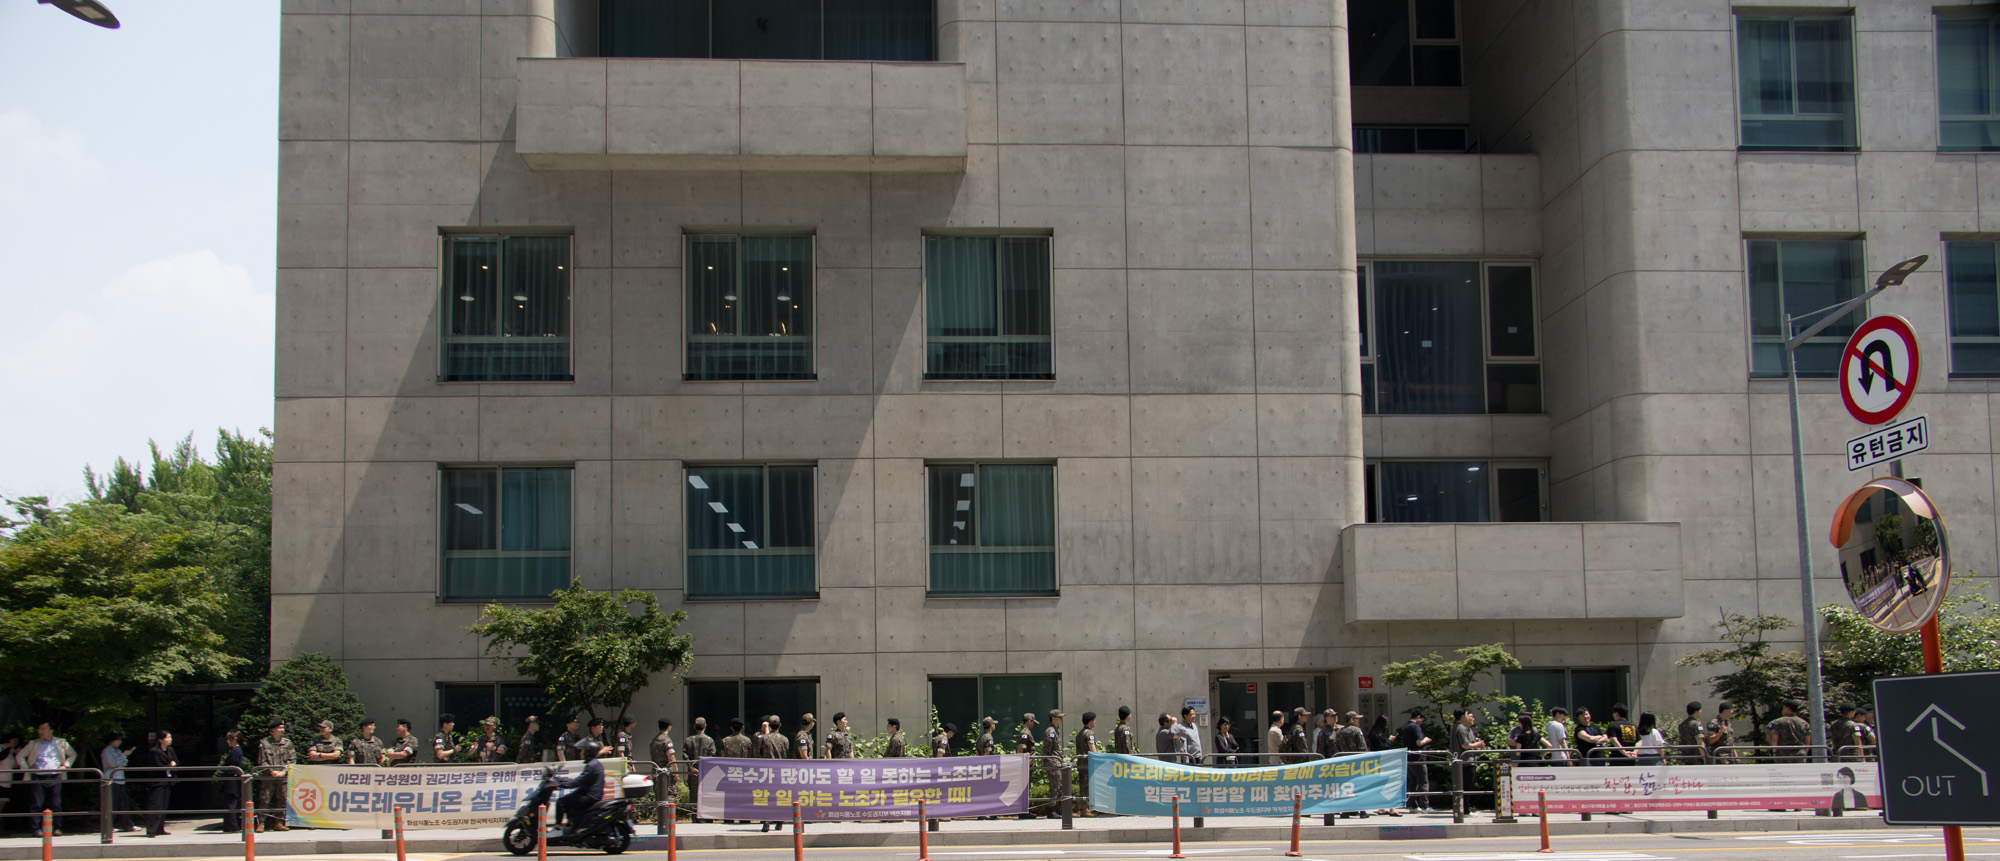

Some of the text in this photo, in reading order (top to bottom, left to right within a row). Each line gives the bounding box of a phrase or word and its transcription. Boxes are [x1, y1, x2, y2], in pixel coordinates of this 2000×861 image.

[1851, 423, 1923, 464] 유턴금지
[337, 773, 371, 785] 아모레
[374, 773, 422, 786] 구성원의
[426, 771, 488, 785] 권리보장을
[491, 770, 517, 783] 위해
[727, 763, 999, 785] 쪽수가 많아도 할 일 못하는 노조보다
[1112, 759, 1385, 782] 아모레유니온이 여러분 곁에 있습니다.
[752, 786, 972, 807] 할 일 하는 노조가 필요한 때!
[1143, 781, 1356, 803] 힘들고 답답할 때 찾아주세요
[1604, 775, 1636, 796] 창업,
[1668, 775, 1704, 795] 말하다
[1902, 775, 1956, 796] OUT
[298, 787, 317, 812] 경
[328, 790, 462, 813] 아모레유니온
[471, 788, 518, 812] 설립
[1272, 805, 1295, 813] 카카오지
